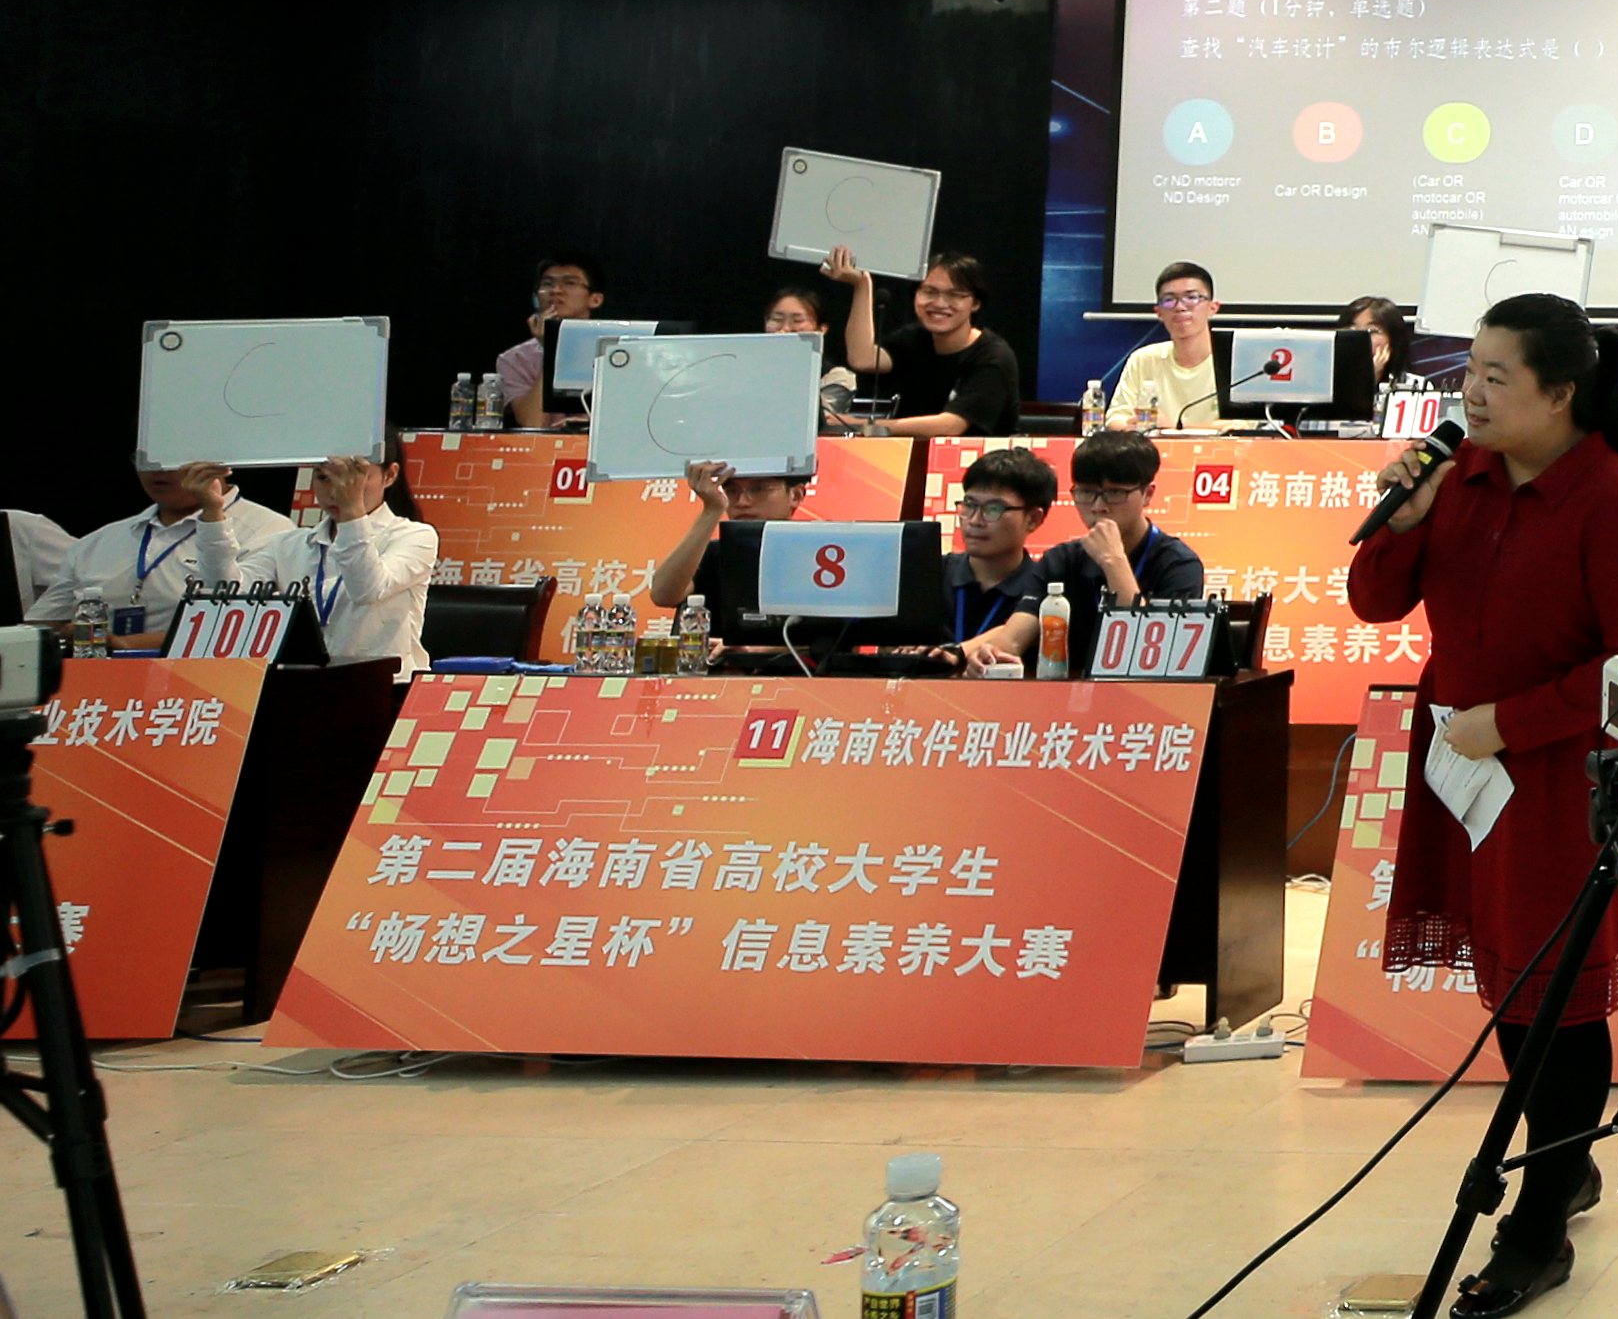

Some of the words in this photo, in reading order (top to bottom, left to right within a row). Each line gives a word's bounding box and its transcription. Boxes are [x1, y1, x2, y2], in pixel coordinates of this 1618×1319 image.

[1187, 122, 1208, 143] A
[1318, 122, 1336, 144] B
[1446, 123, 1466, 144] C
[1574, 123, 1595, 145] D
[1275, 184, 1297, 198] Car
[1300, 184, 1322, 198] OR
[1324, 184, 1367, 200] Design
[1443, 174, 1464, 188] OR
[1558, 175, 1582, 189] Car
[1584, 175, 1606, 189] OR
[825, 176, 875, 233] C
[1187, 190, 1230, 207] Design
[1465, 191, 1486, 204] OR
[223, 342, 287, 418] C
[647, 353, 738, 456] C
[556, 466, 587, 491] 01
[1195, 473, 1230, 497] 04
[811, 543, 847, 590] 8
[181, 608, 282, 659] 100
[1102, 619, 1205, 673] 087
[746, 717, 787, 751] 11
[800, 716, 1196, 773] 海南软件职业技术学院
[366, 833, 1002, 899] 第二届海南省高校大学生
